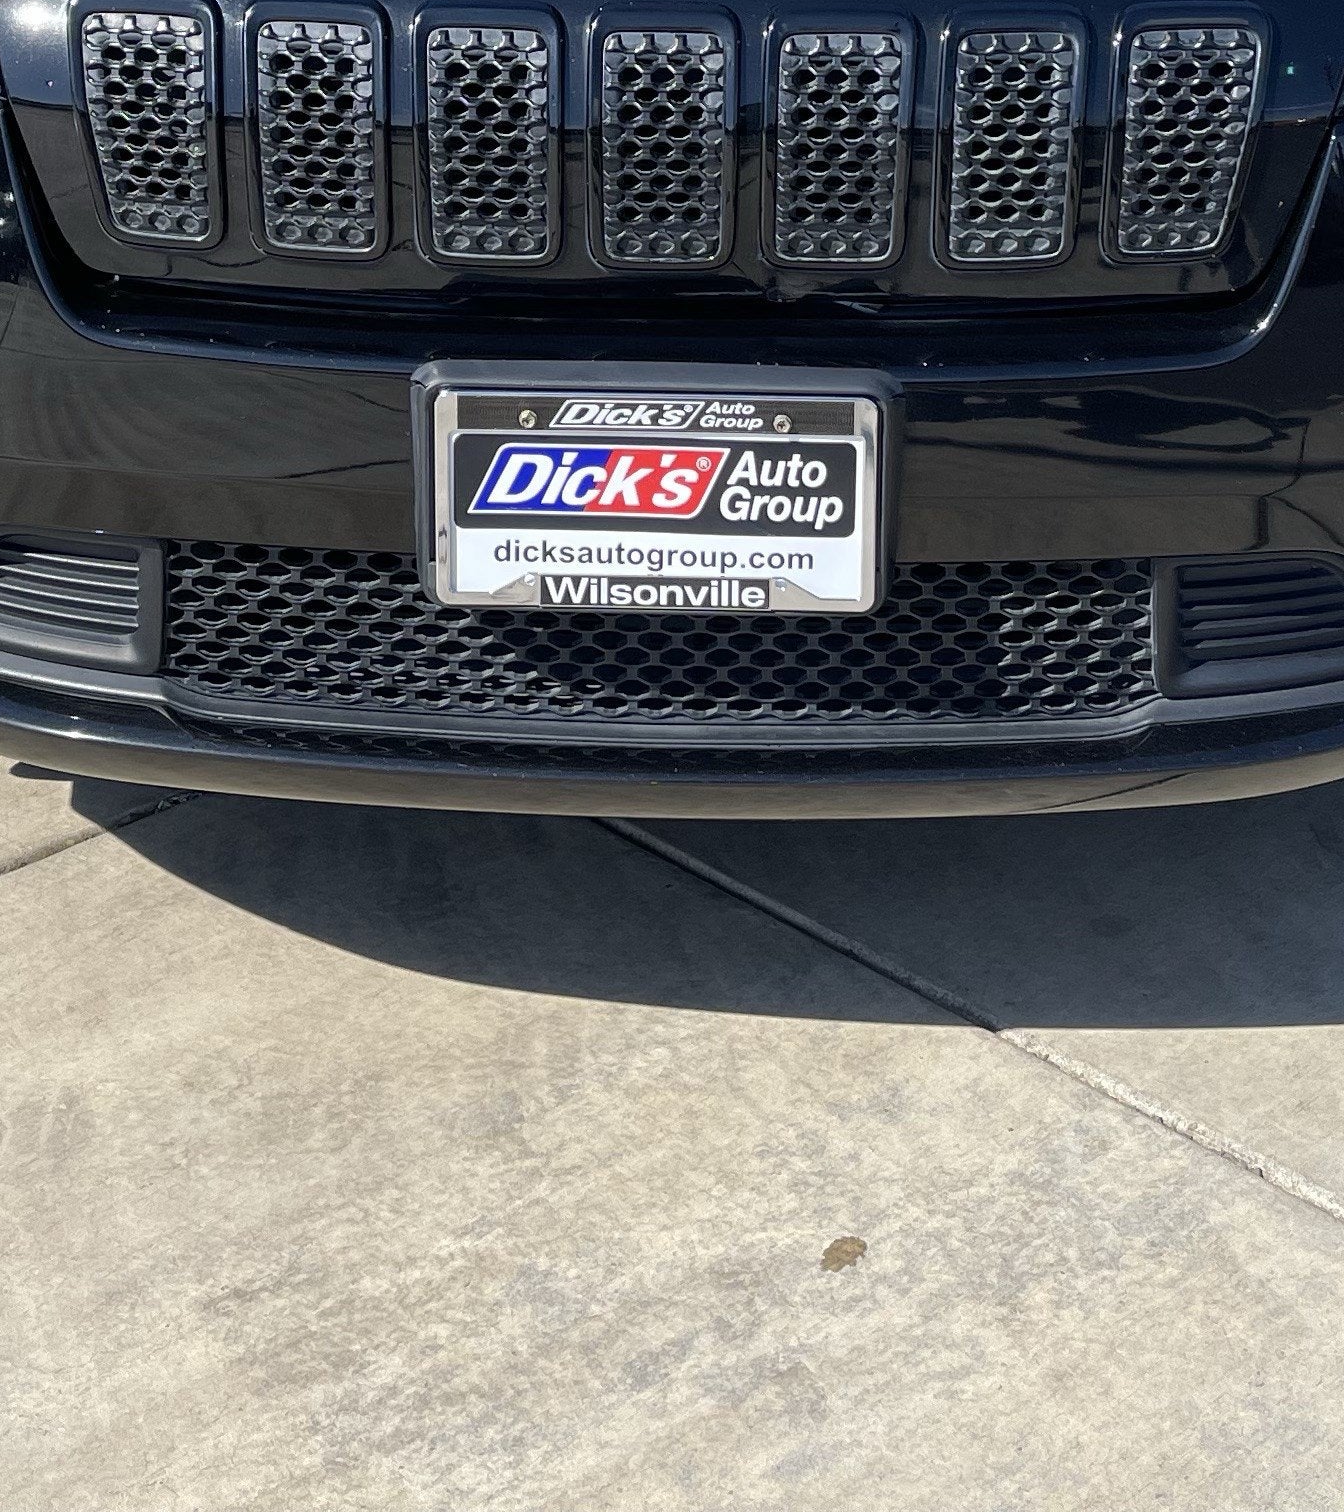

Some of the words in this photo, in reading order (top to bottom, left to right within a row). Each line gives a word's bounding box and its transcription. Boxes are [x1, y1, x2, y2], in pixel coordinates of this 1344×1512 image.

[700, 414, 764, 431] Group
[709, 402, 755, 416] Auto
[727, 451, 827, 488] Auto
[719, 487, 845, 531] Group
[493, 539, 815, 573] dicksautogroup.com
[543, 577, 767, 608] Wilsonville
